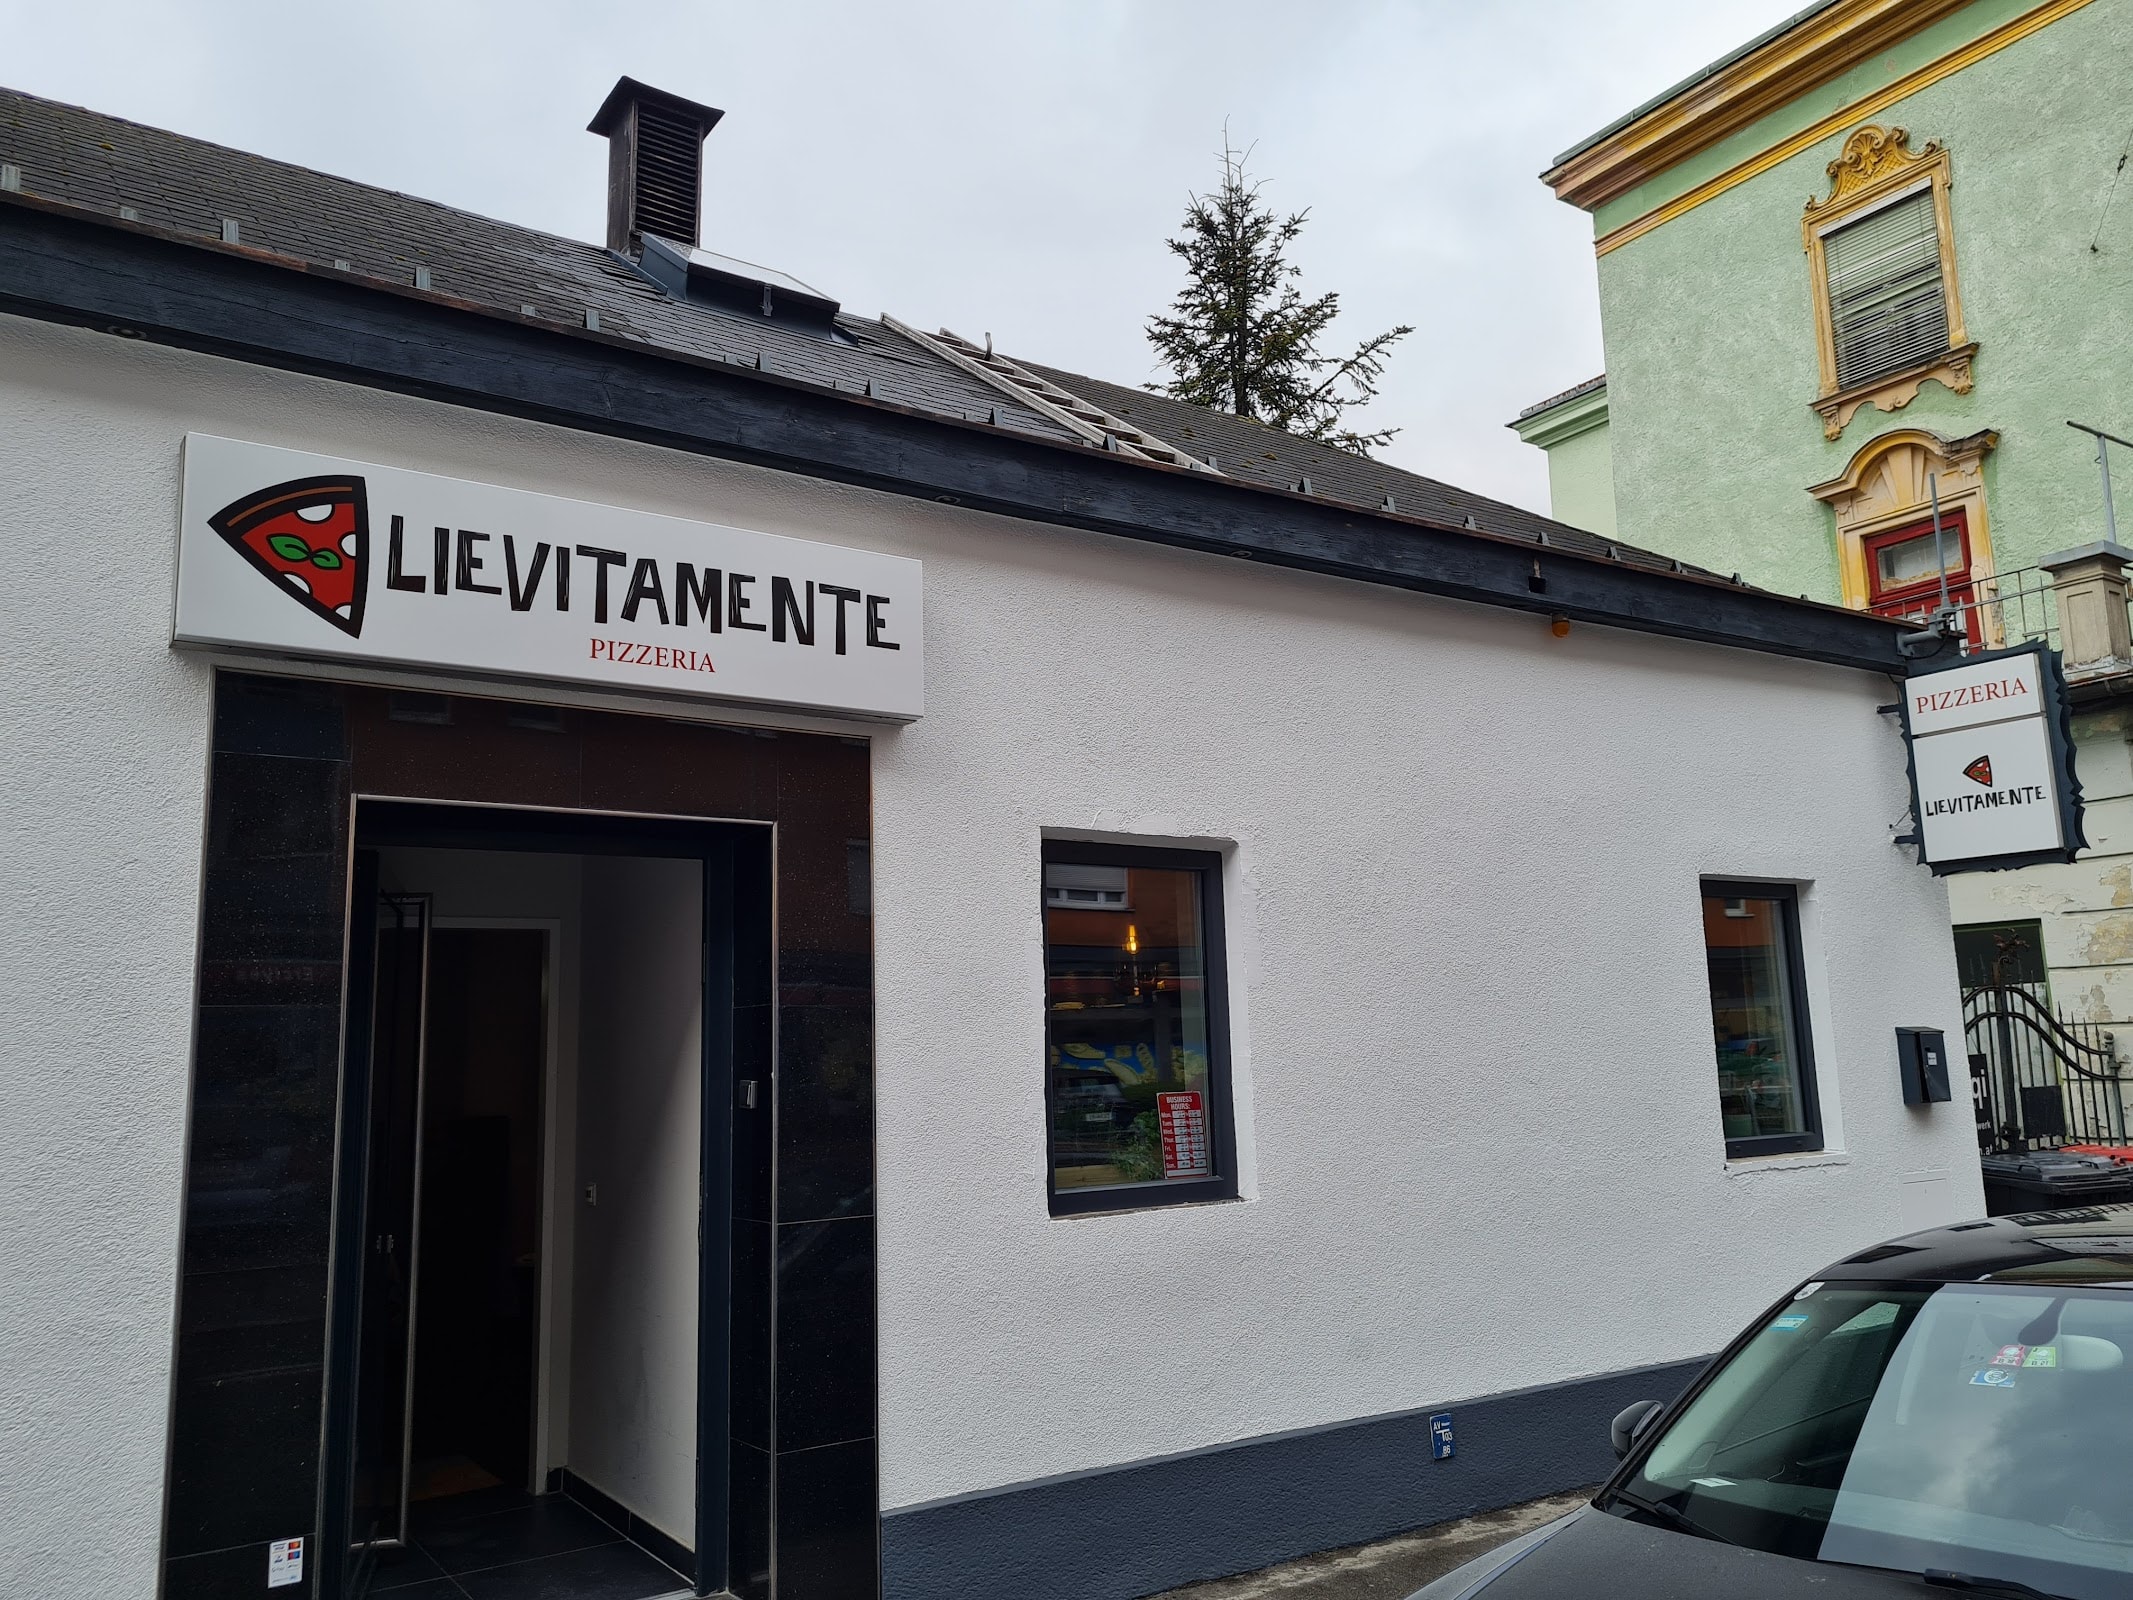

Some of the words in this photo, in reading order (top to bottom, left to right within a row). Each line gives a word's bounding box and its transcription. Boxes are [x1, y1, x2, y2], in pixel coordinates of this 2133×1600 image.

[386, 514, 901, 656] LIEVITAMENTE
[589, 638, 716, 673] PIZZERIA
[1915, 677, 2028, 714] PIZZERIA
[1925, 785, 2046, 817] LIEVITAMENTE
[1166, 1095, 1193, 1104] BUSINESS
